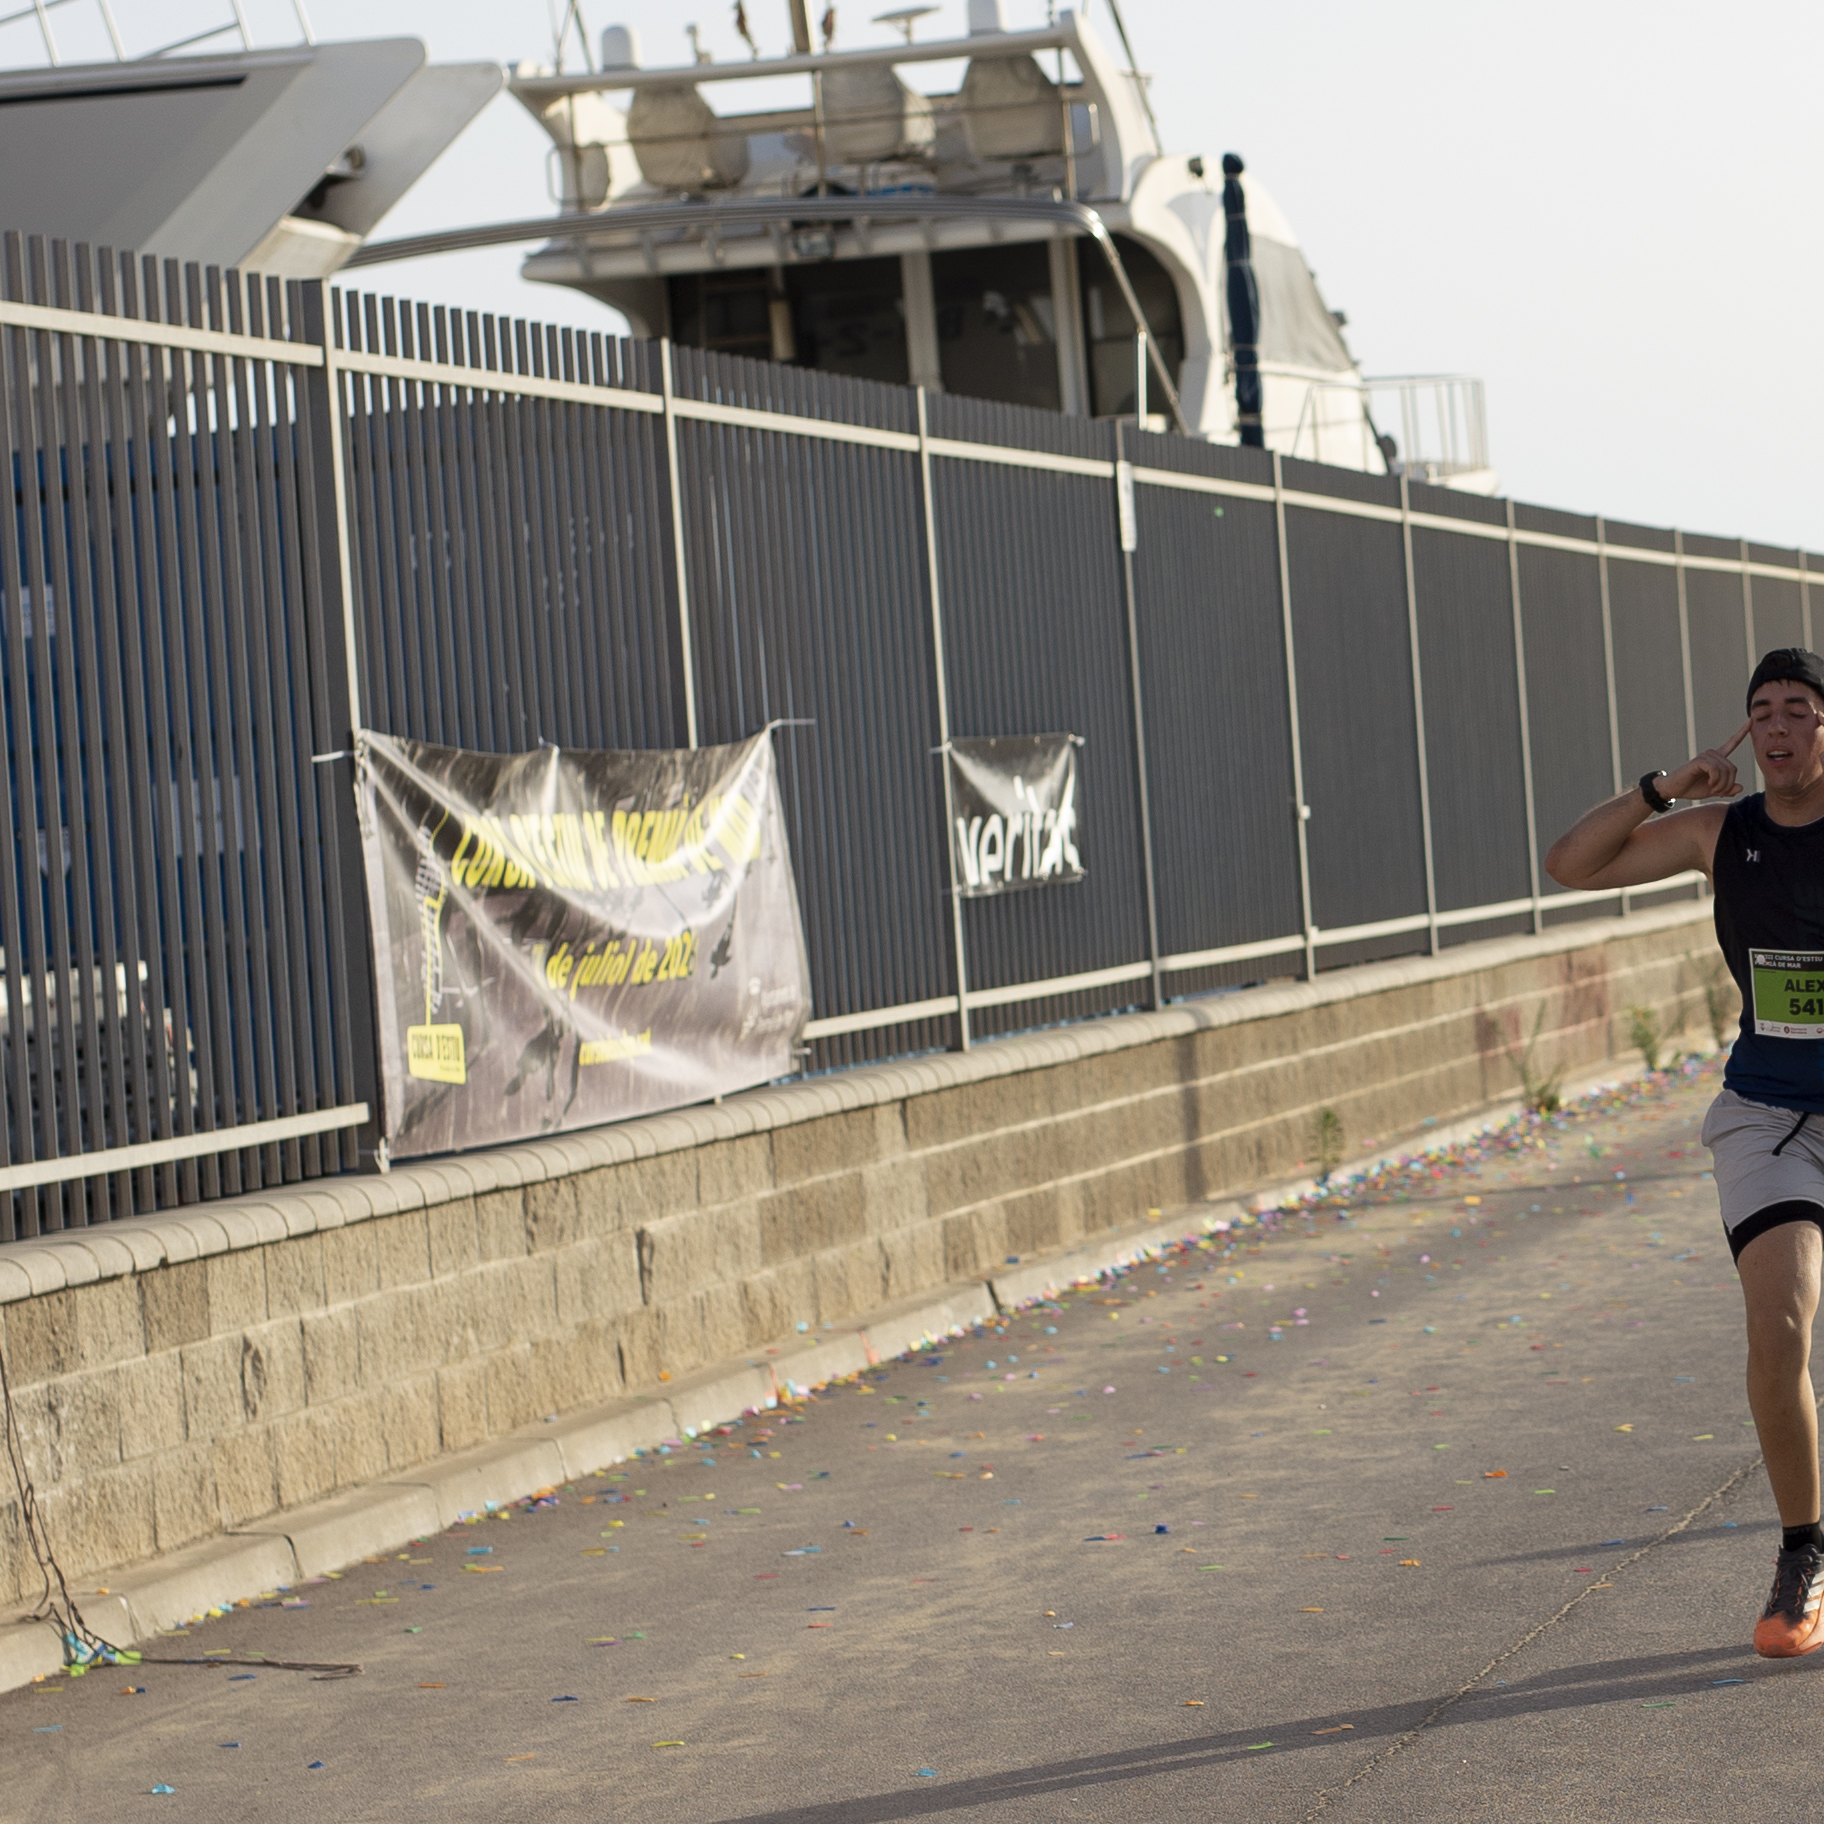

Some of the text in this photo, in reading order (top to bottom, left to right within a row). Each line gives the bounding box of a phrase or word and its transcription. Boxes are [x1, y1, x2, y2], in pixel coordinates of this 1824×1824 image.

[546, 942, 574, 990] de
[631, 937, 658, 984] de
[1789, 998, 1824, 1016] 541
